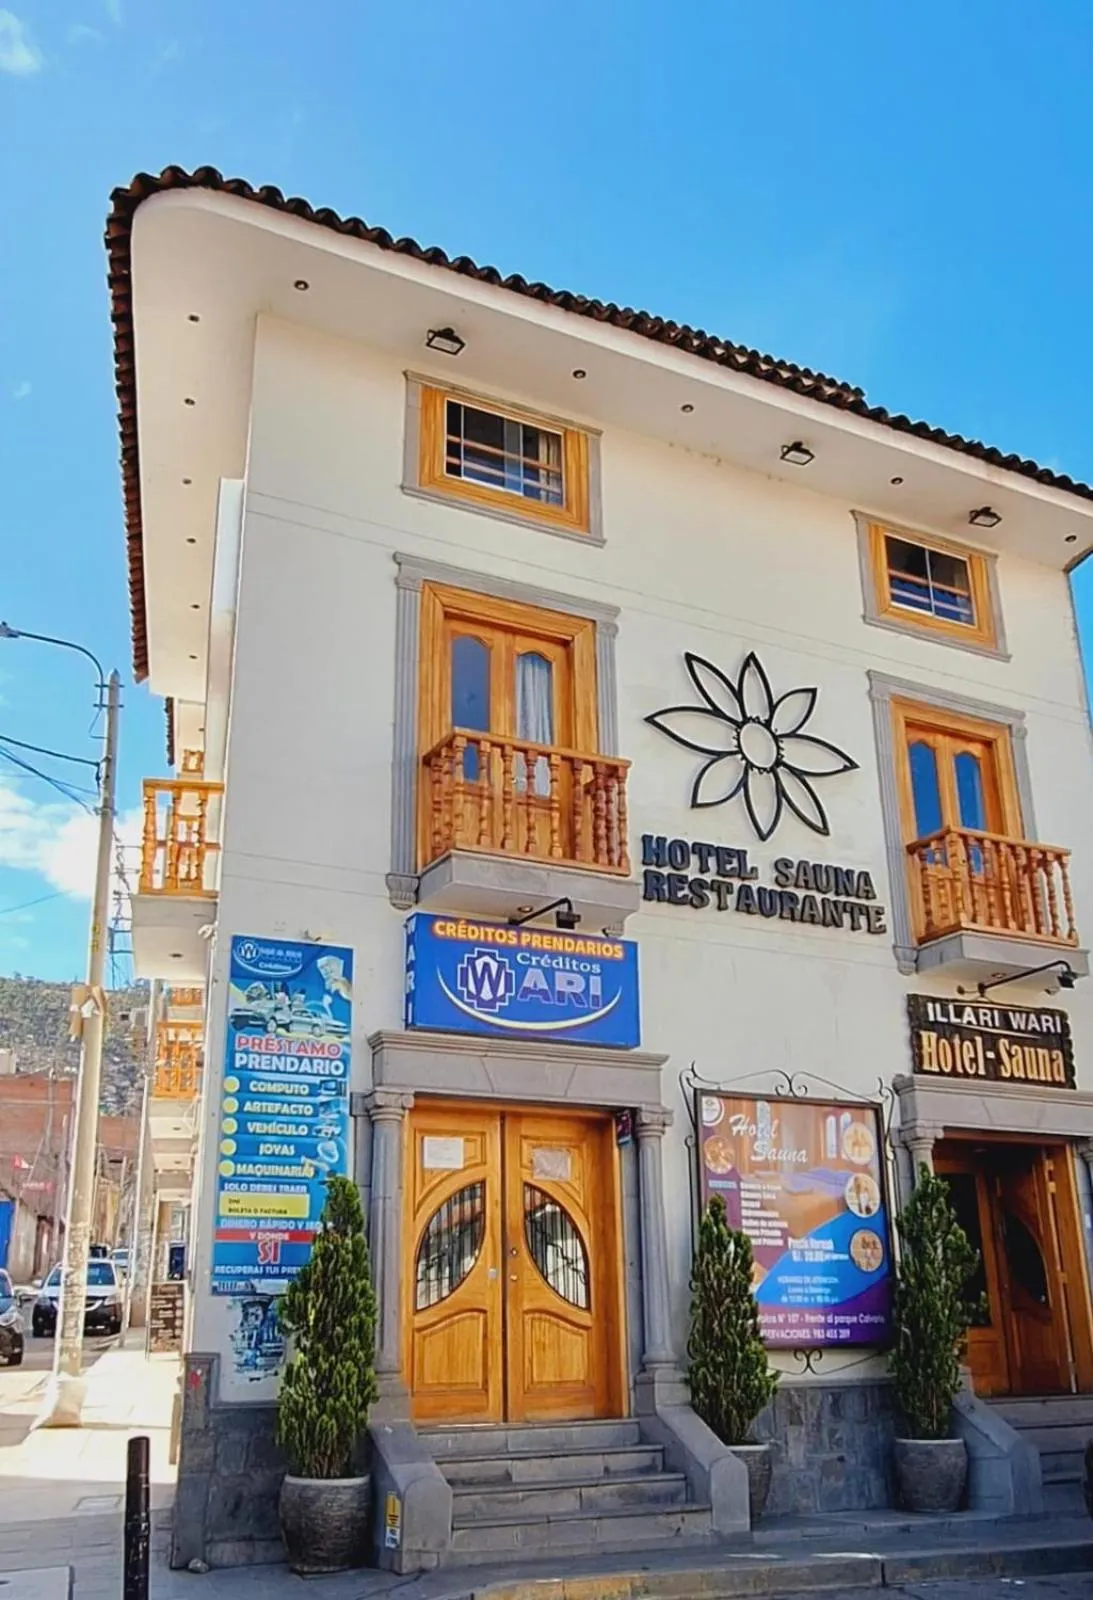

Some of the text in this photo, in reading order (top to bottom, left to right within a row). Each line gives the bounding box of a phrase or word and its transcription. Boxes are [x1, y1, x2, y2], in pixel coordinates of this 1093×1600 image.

[641, 834, 877, 900] HOTEL SAUNA
[642, 869, 887, 934] RESTAURANTE
[434, 919, 623, 958] CRÉDITOS PRENDARIOS
[516, 952, 601, 974] Créditos
[926, 1002, 1062, 1034] ILLARI WARI
[237, 1033, 341, 1058] PRÉSTAMO
[235, 1053, 345, 1075] PRENDARIO
[250, 1080, 309, 1094] COMPUTO
[243, 1102, 314, 1115] ARTEFACTO
[729, 1114, 780, 1138] Hotel
[259, 1144, 295, 1155] JOYAS
[751, 1140, 808, 1163] Sauna
[224, 1183, 248, 1192] SOLO
[215, 1265, 263, 1275] RECUPERAS
